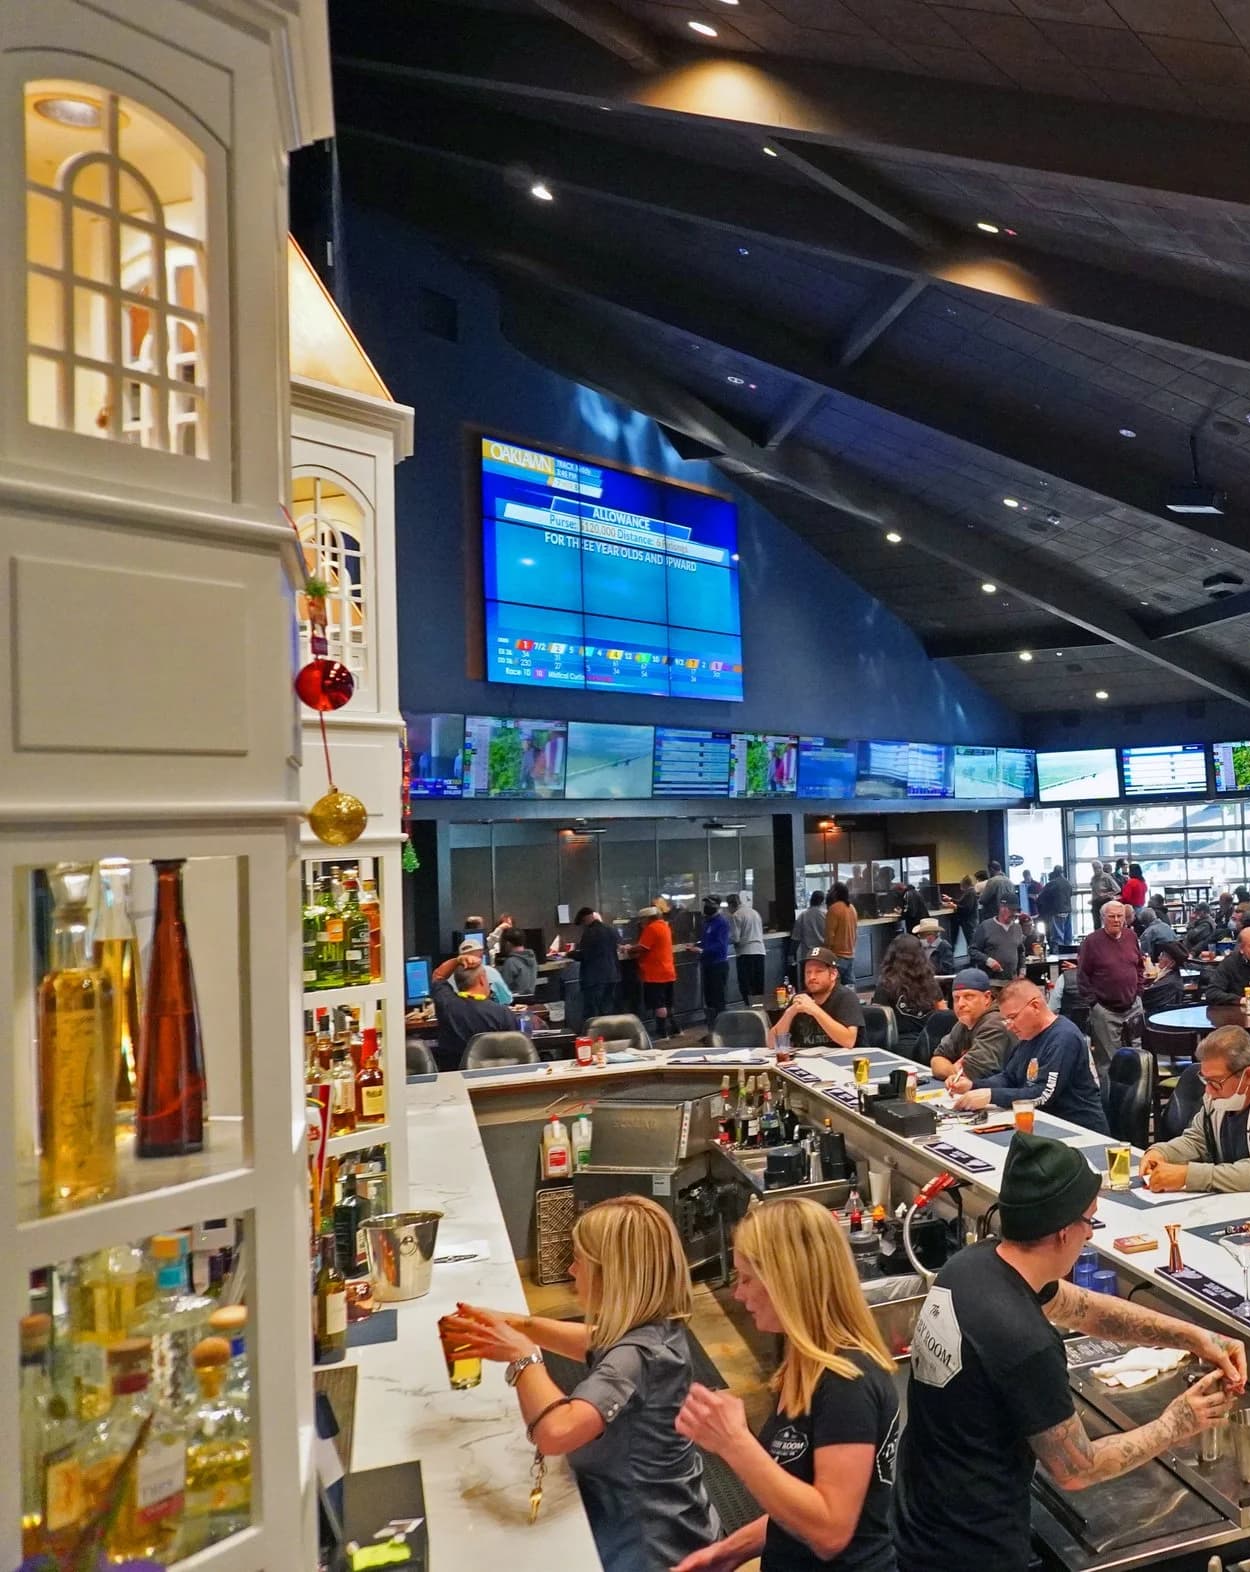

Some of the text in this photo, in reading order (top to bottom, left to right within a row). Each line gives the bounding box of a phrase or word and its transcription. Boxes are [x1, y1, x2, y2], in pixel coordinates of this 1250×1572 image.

[550, 514, 576, 530] Purse:
[592, 508, 650, 530] ALLOWANCE
[544, 531, 564, 545] FOR
[597, 543, 621, 558] YEAR
[621, 547, 643, 562] OLDS
[645, 553, 664, 566] AND
[811, 946, 820, 956] B
[924, 1331, 952, 1367] ROOM
[781, 1441, 805, 1450] ROOM
